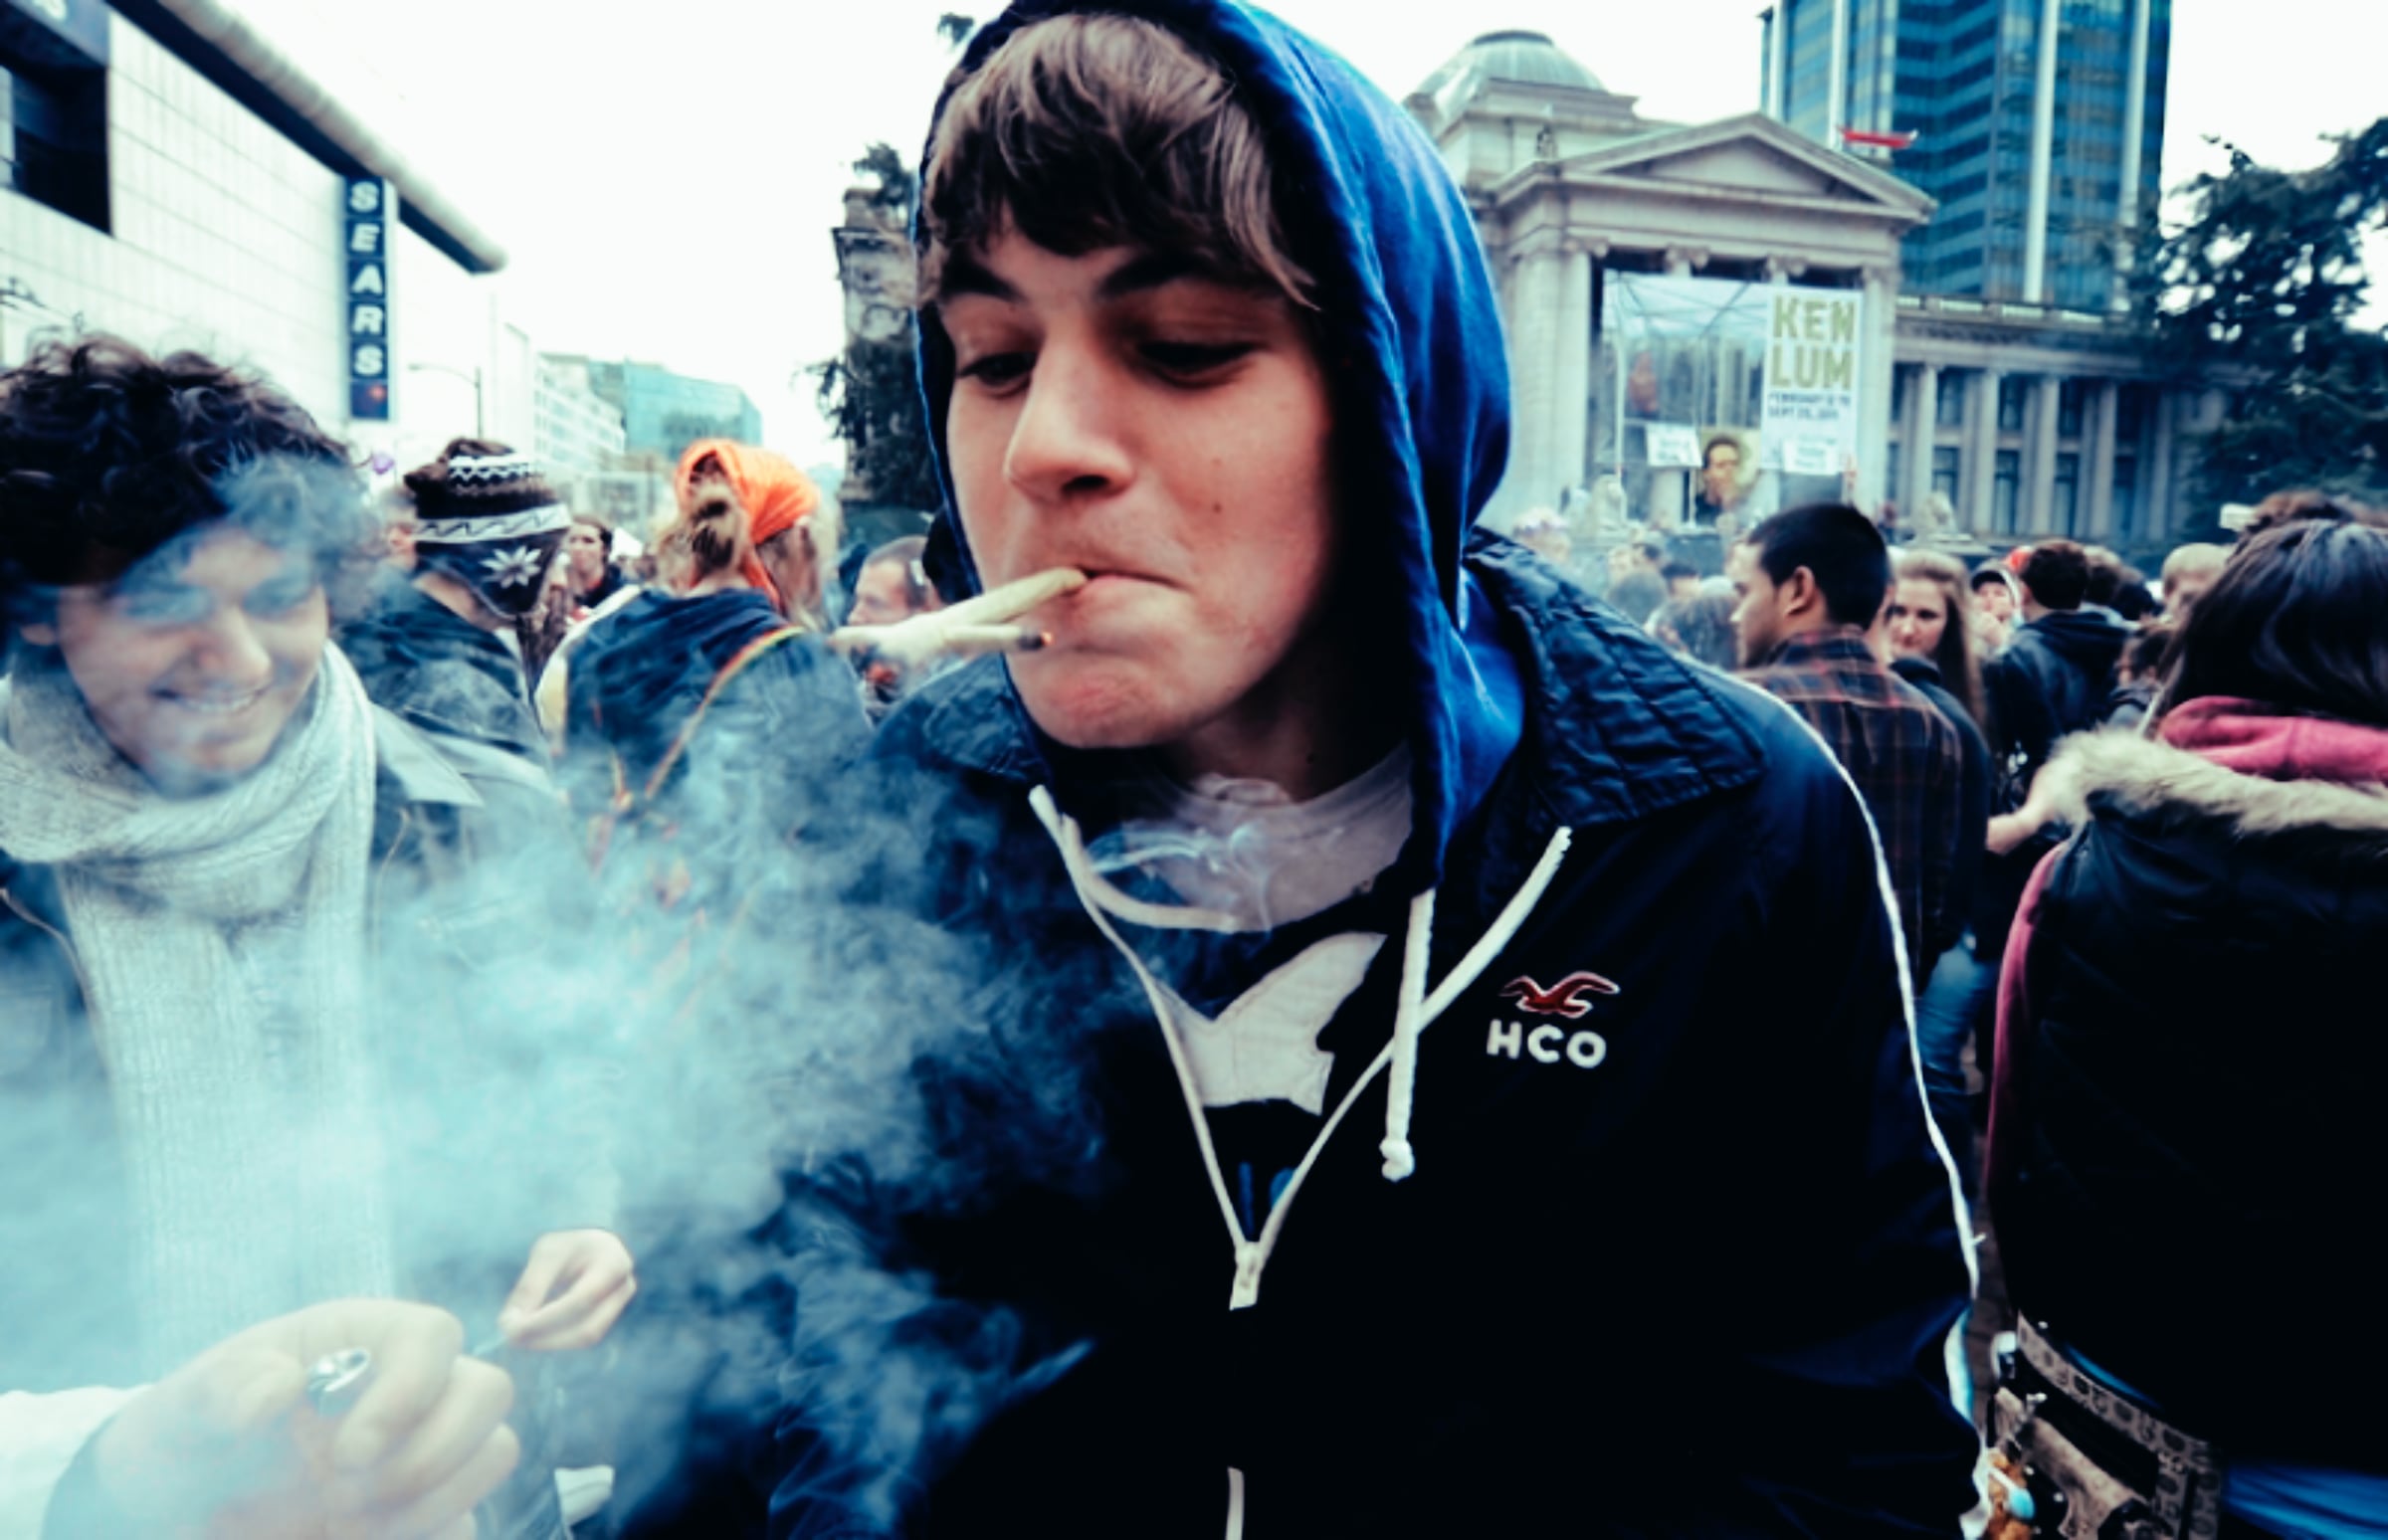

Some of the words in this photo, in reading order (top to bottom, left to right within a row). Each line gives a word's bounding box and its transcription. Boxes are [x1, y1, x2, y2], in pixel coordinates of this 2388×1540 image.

[350, 180, 384, 376] SEARS
[1773, 294, 1856, 342] KEN
[1770, 344, 1853, 390] LUM
[1487, 1019, 1607, 1068] HCO
